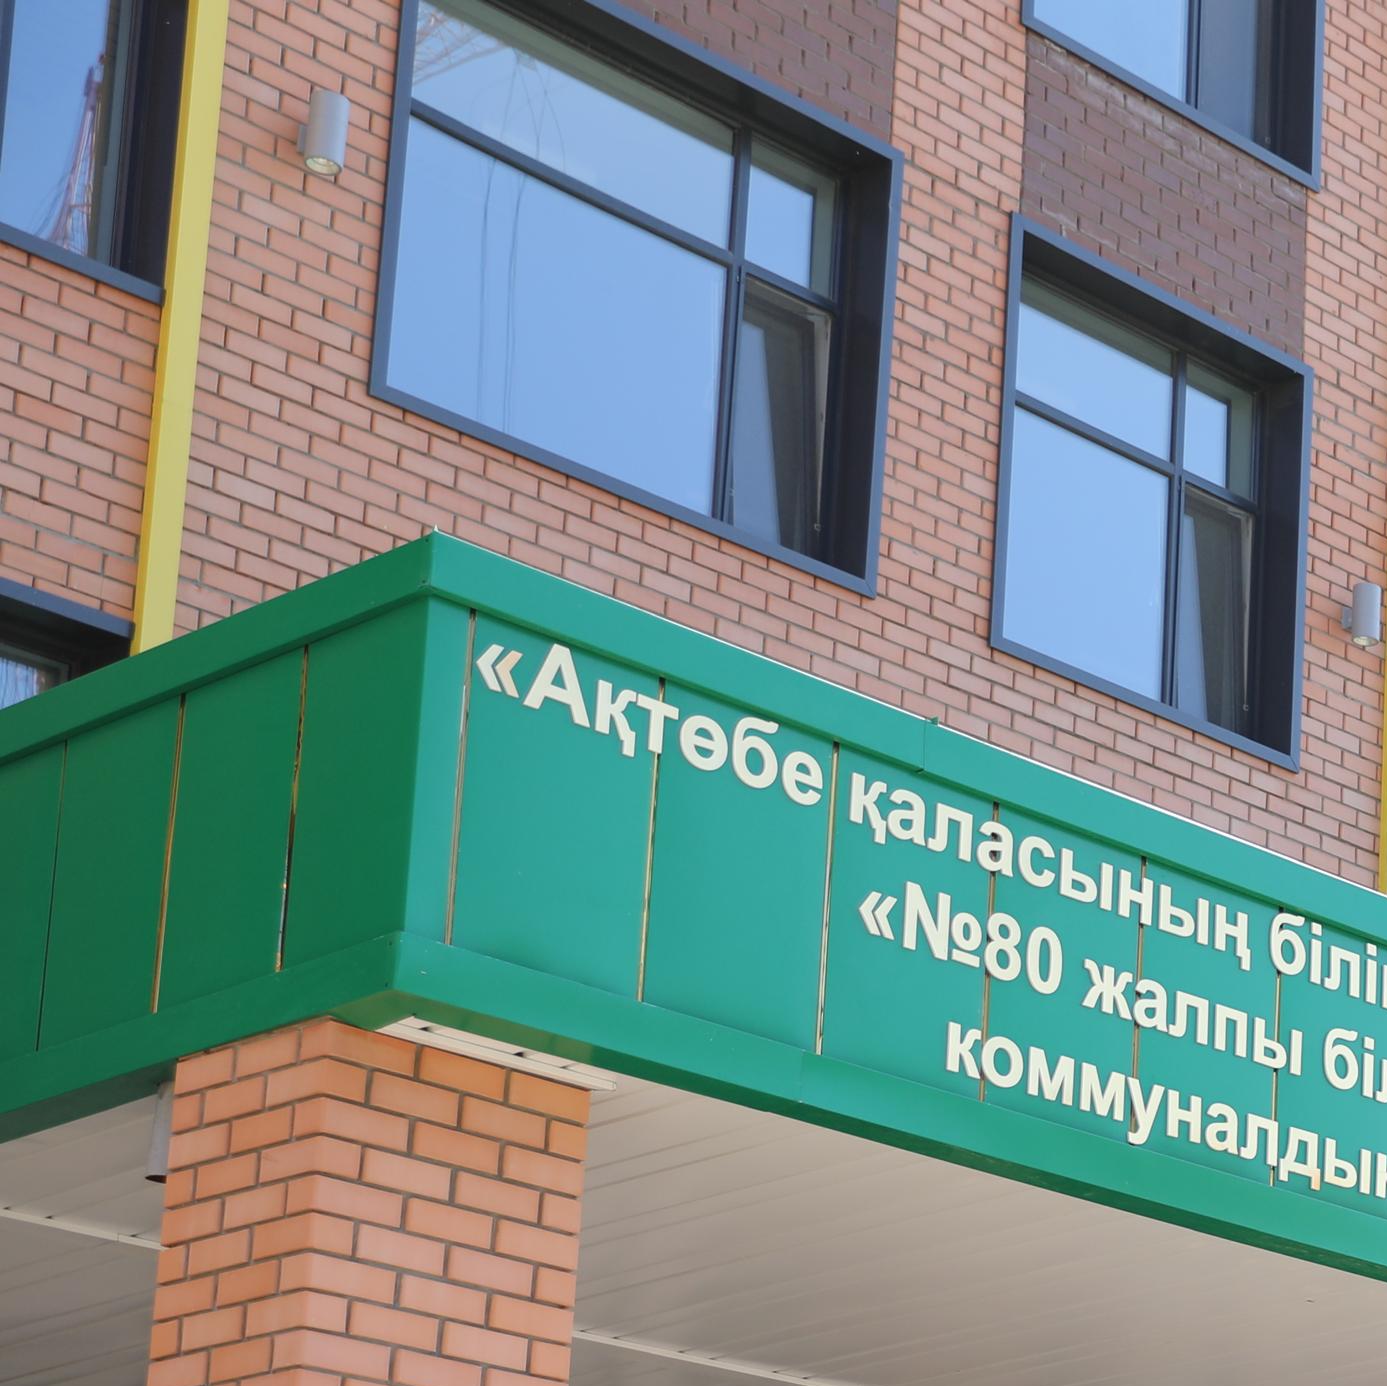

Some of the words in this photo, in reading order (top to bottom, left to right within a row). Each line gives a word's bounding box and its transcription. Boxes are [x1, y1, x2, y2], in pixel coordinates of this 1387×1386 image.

[476, 643, 823, 806] «Ақтөбе
[850, 773, 1251, 970] қаласының
[859, 882, 1063, 993] «№80
[1083, 959, 1303, 1075] жалпы
